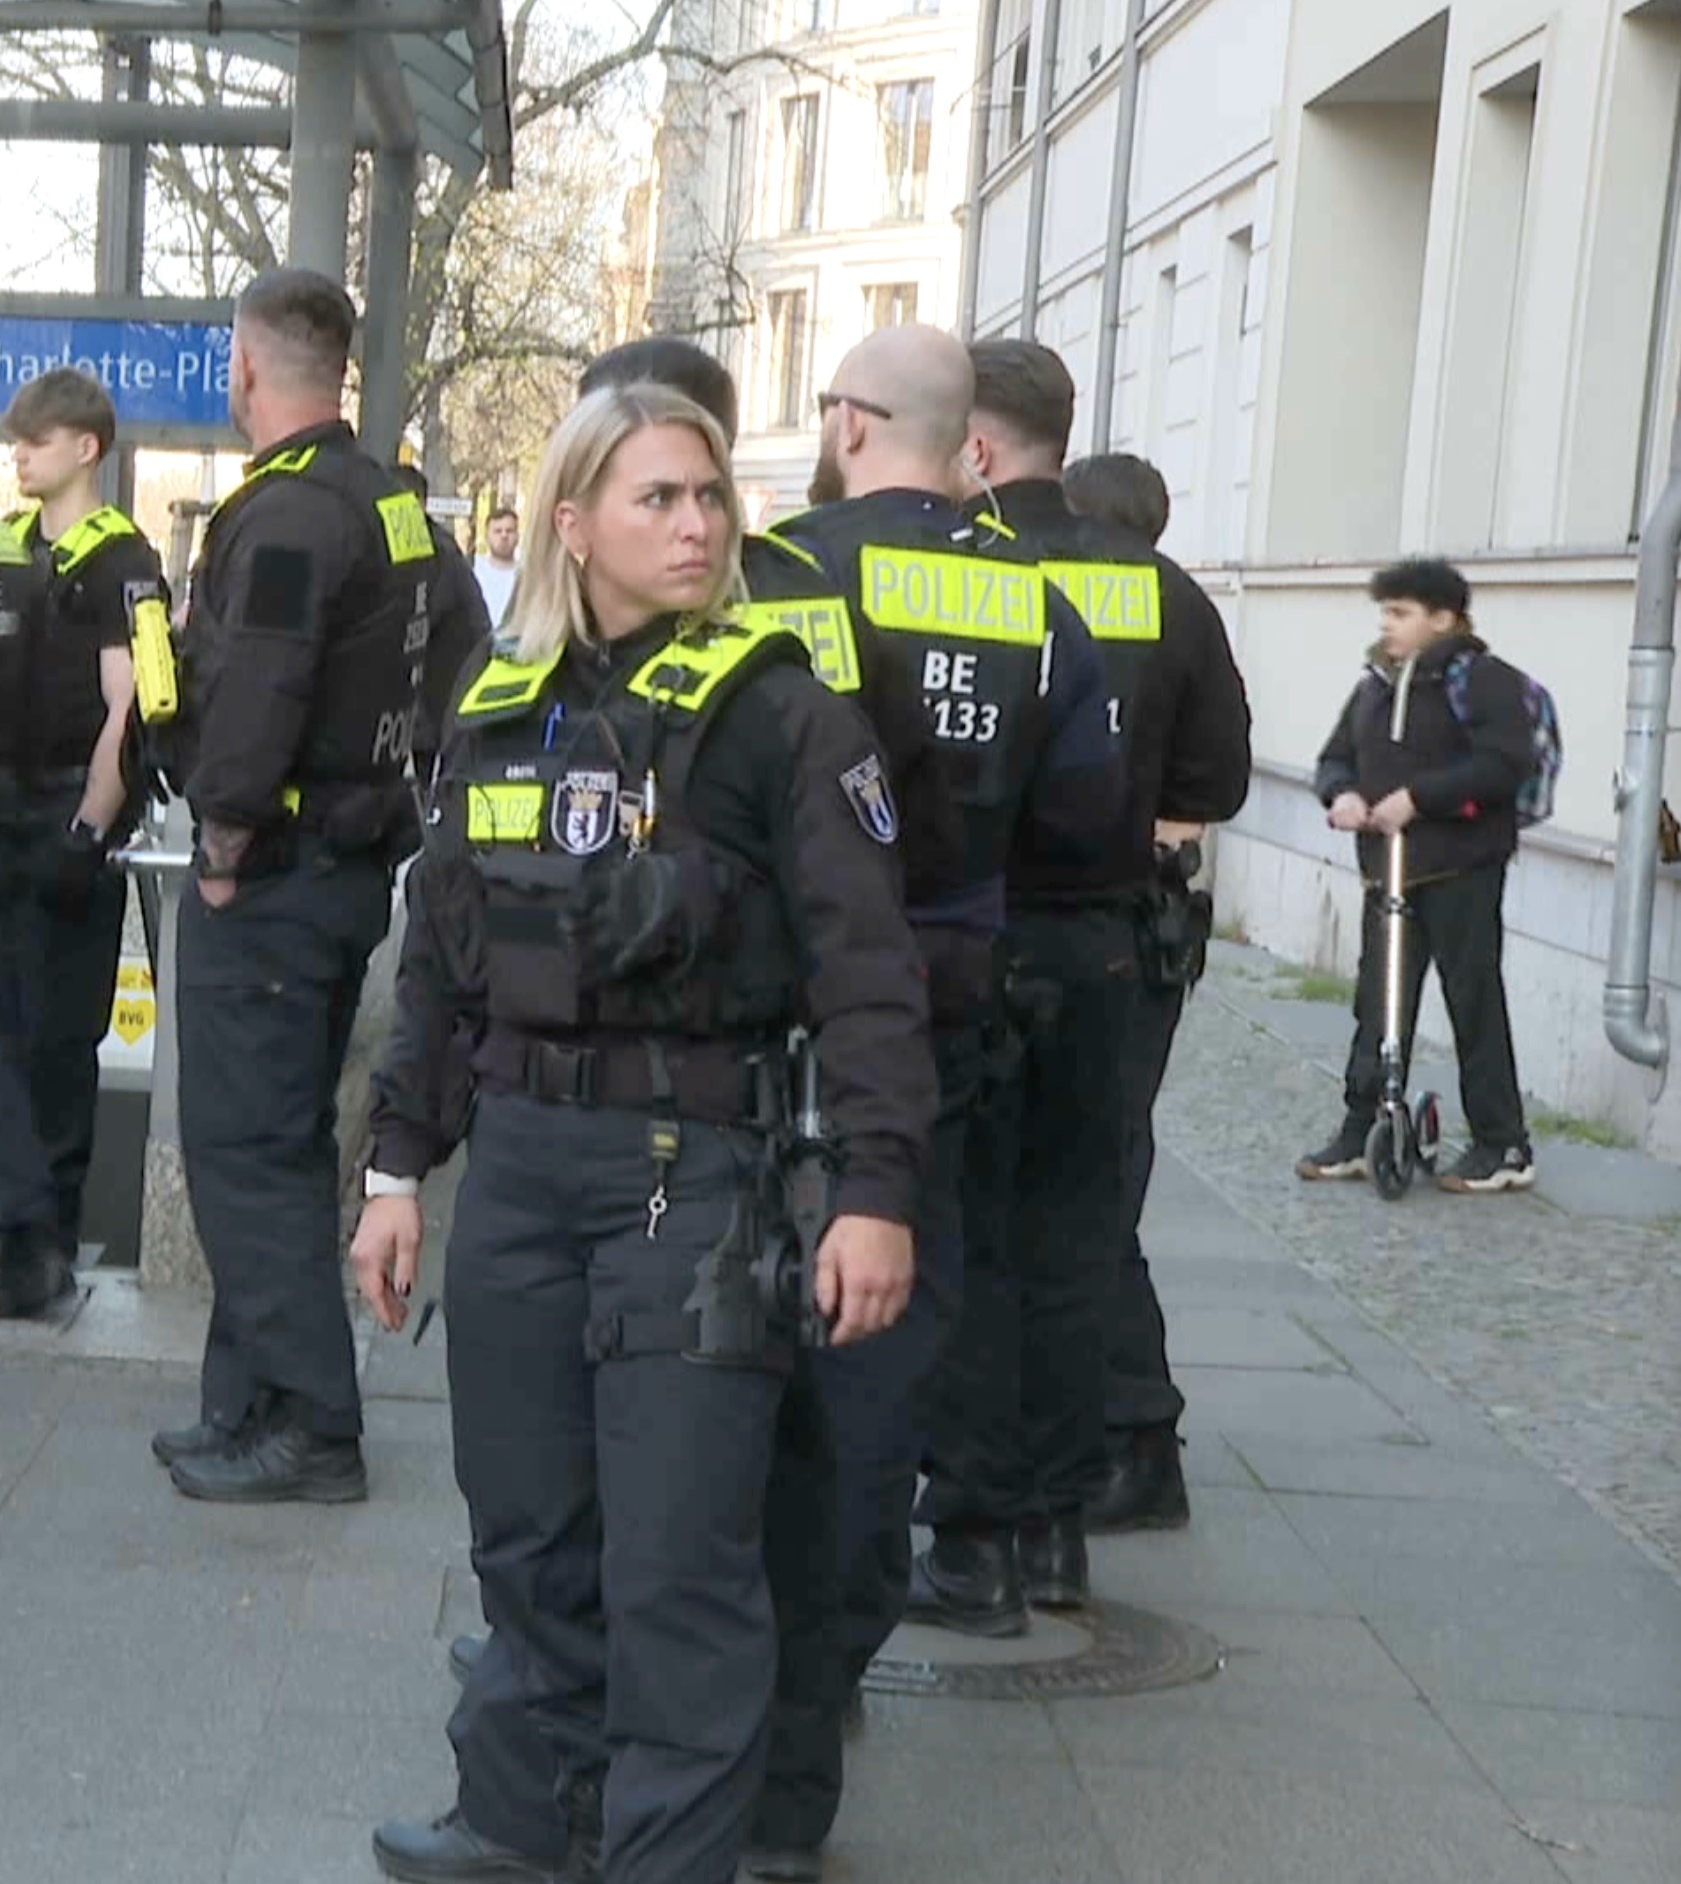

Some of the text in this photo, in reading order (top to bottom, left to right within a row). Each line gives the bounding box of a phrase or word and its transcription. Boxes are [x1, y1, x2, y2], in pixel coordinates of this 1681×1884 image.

[872, 559, 1034, 632] POLIZEI
[1057, 575, 1151, 627] IZEI
[922, 650, 978, 694] BE
[923, 697, 1000, 742] 133
